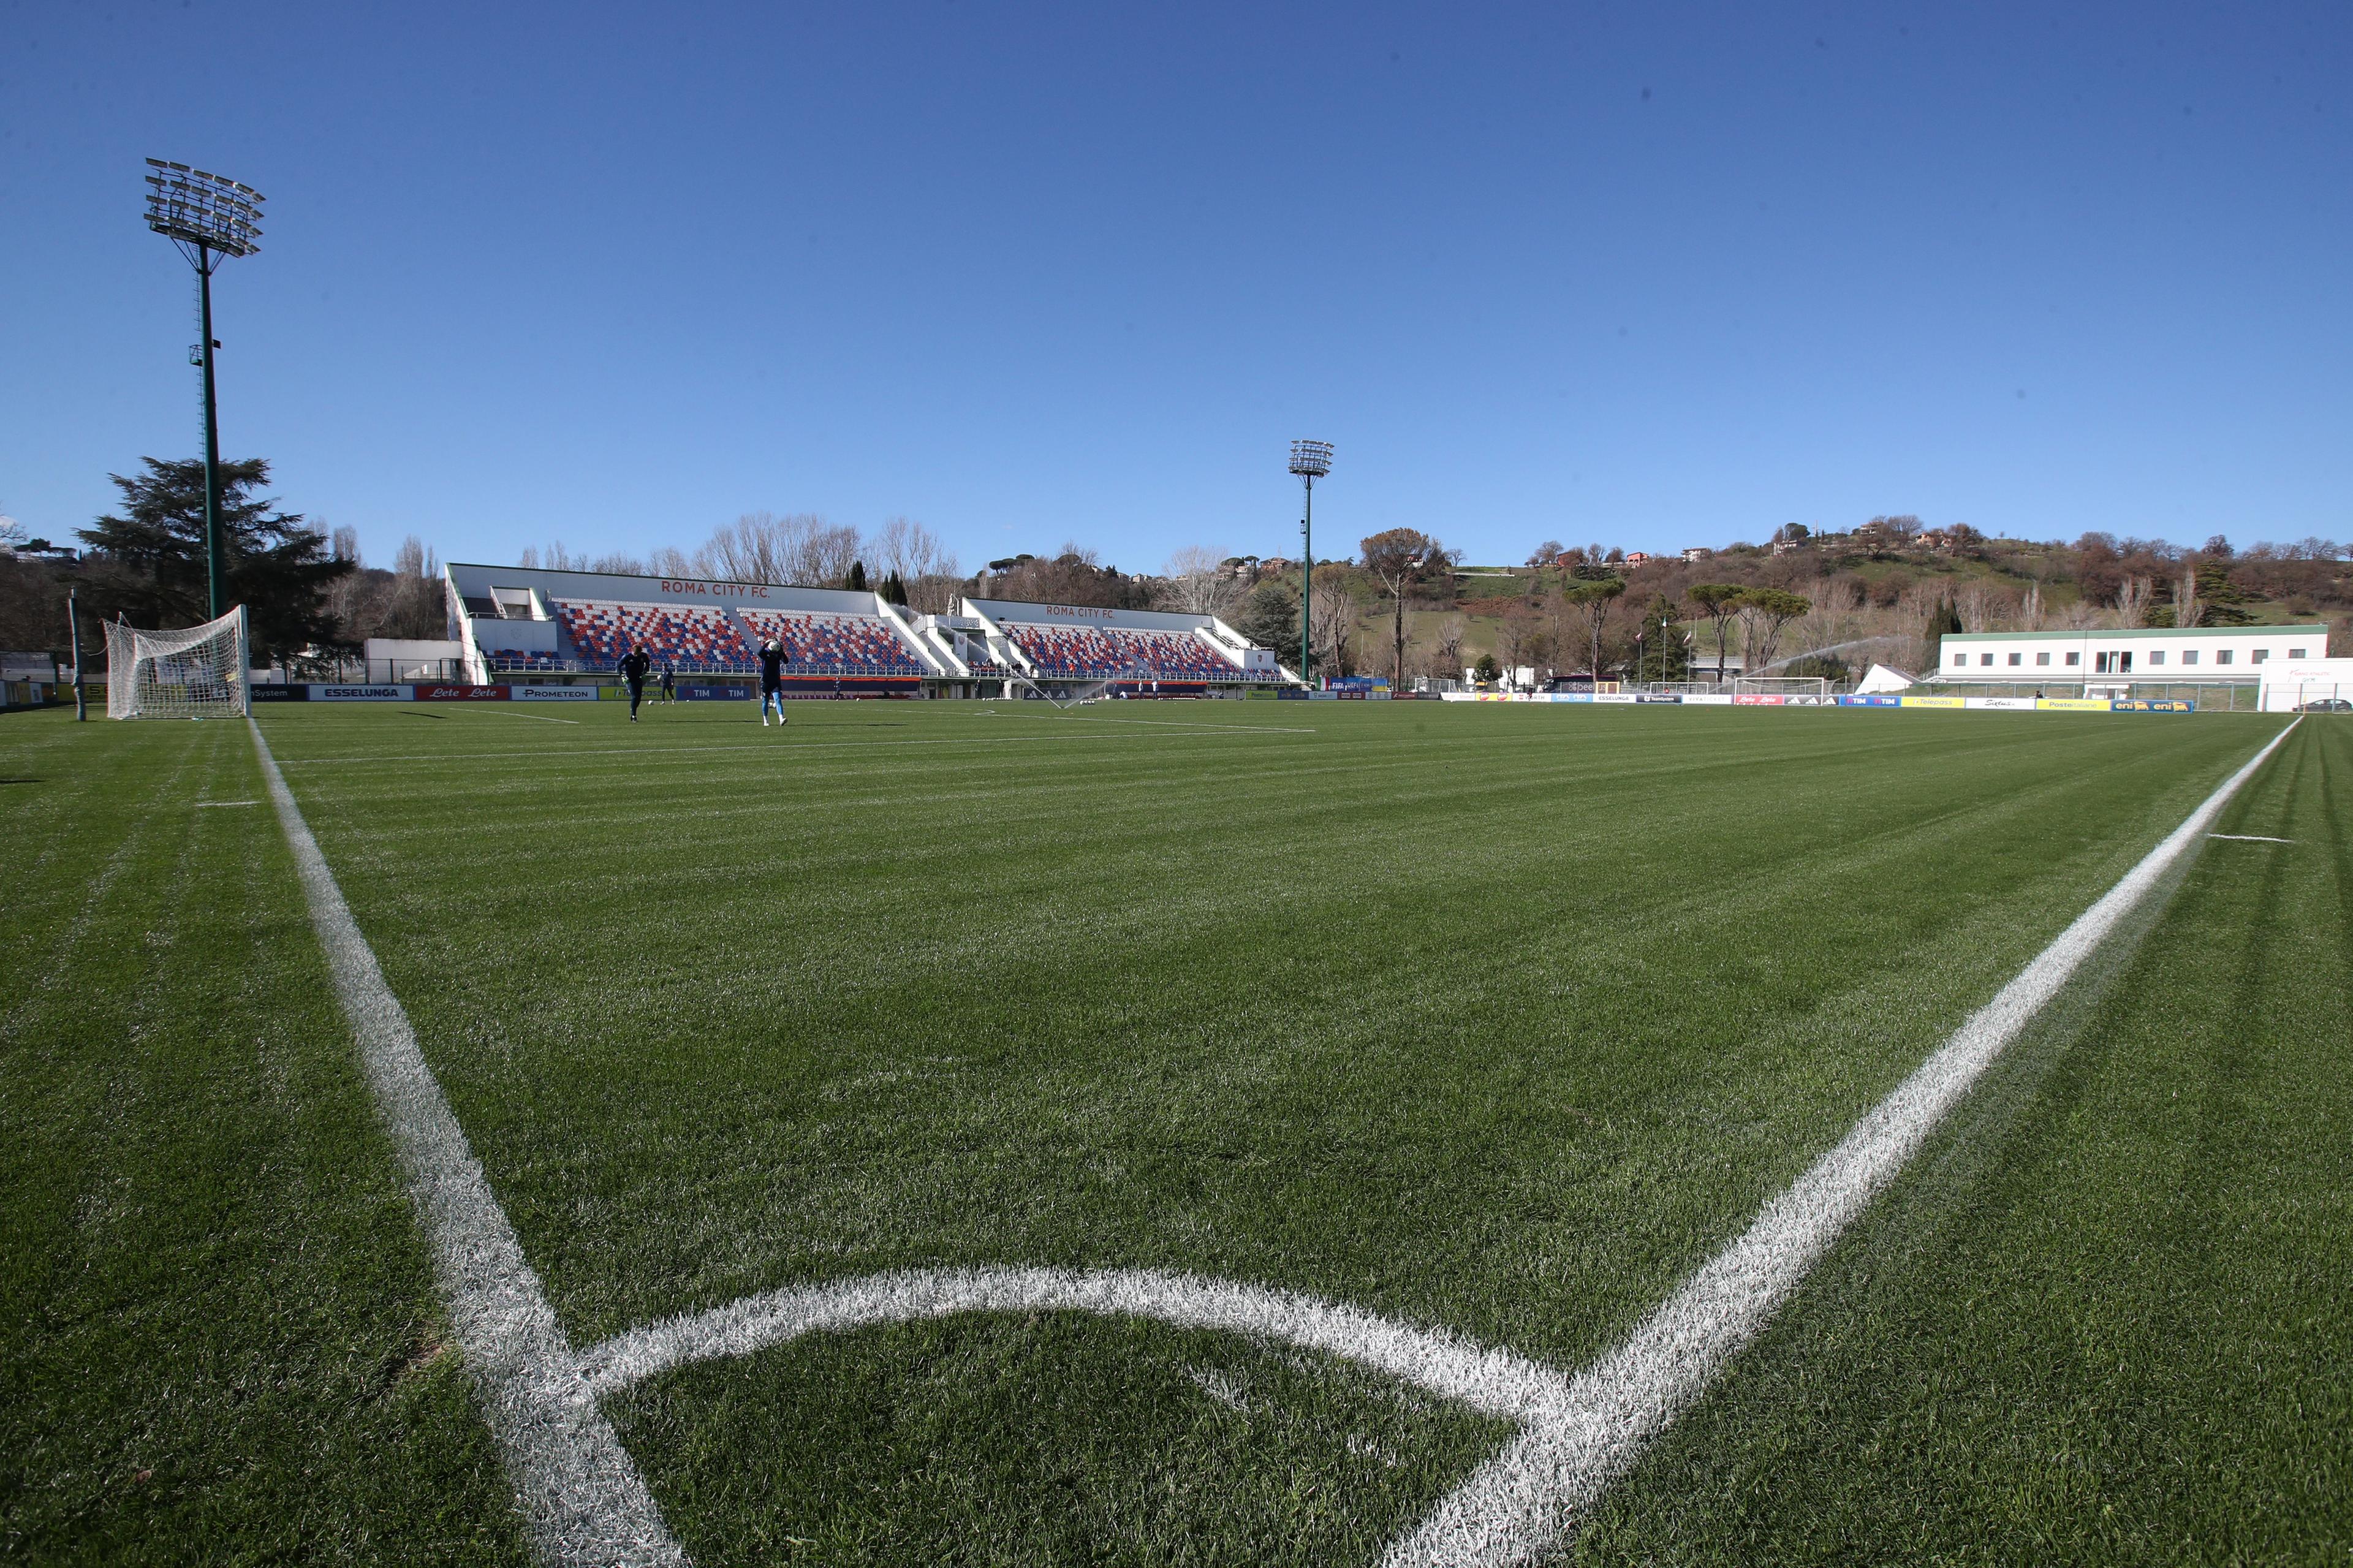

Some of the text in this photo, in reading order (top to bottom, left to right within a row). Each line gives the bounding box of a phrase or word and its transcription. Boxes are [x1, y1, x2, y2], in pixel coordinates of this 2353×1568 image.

[661, 580, 770, 598] ROMA CITY F.C.
[1047, 605, 1074, 616] ROMA
[1078, 608, 1099, 618] CITY
[324, 689, 399, 697] ESSELUNGA
[429, 687, 497, 697] Lete Lete
[524, 689, 588, 697] PROMETEON
